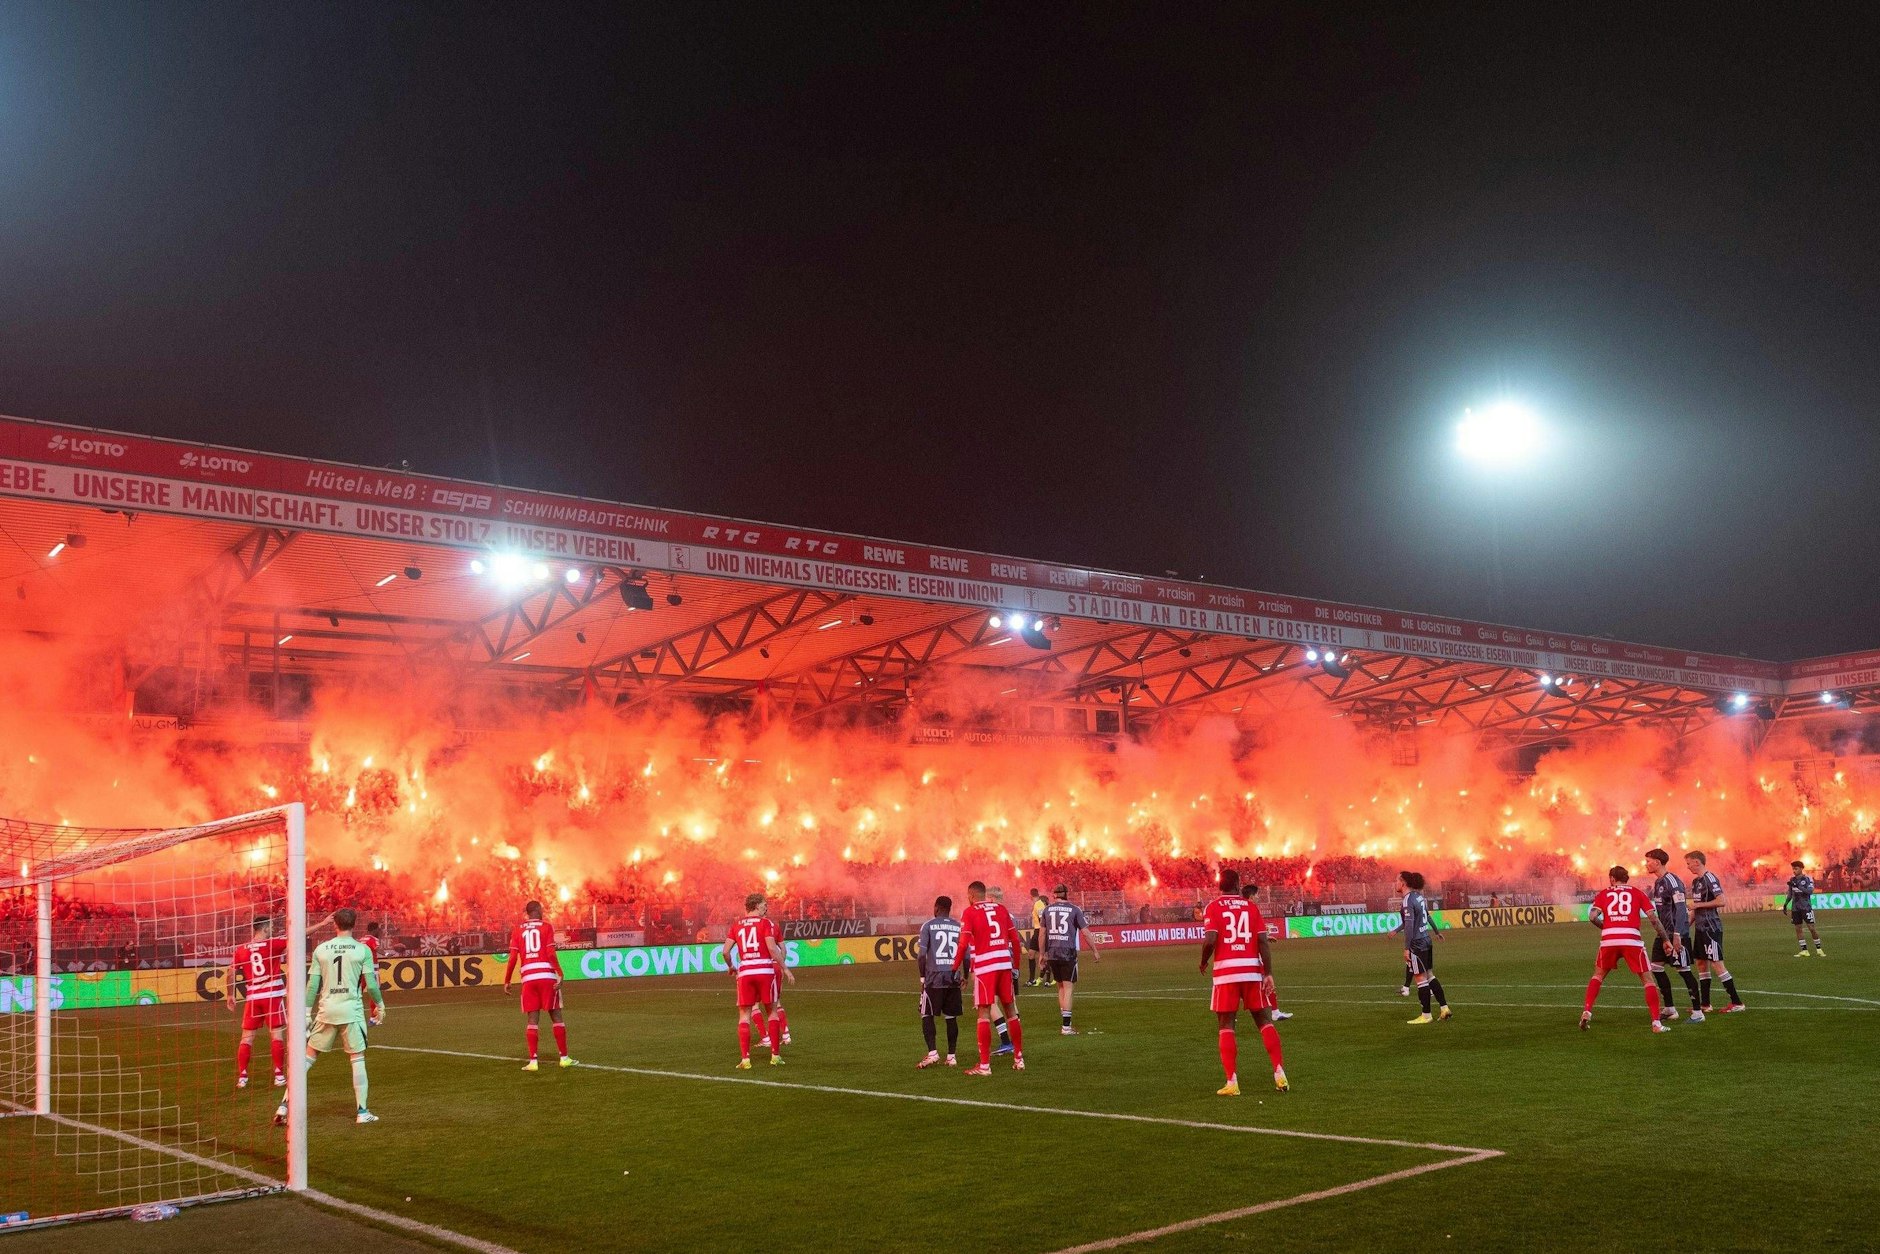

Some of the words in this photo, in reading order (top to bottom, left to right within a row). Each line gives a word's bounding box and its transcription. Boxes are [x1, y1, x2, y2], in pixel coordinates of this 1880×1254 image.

[71, 438, 125, 457] LOTTO
[201, 455, 250, 473] LOTTO
[73, 473, 171, 506] UNSERE
[182, 486, 343, 528] MANNSCHAFT.
[356, 508, 425, 537] UNSER
[430, 517, 497, 546] STOLZ.
[506, 526, 568, 554] UNSER
[572, 534, 642, 562] VEREIN.
[432, 489, 492, 512] ospa
[504, 499, 669, 533] SCHWIMMBADTECHNIK
[702, 526, 761, 545] RTC
[785, 537, 839, 555] RTC
[863, 546, 906, 565] REWE
[930, 555, 969, 573] REWE
[706, 552, 740, 573] UND
[744, 556, 812, 581] NIEMALS
[815, 564, 902, 592] VERGESSEN:
[908, 576, 955, 598] EISERN
[958, 583, 1004, 604] UNION!
[990, 562, 1028, 581] REWE
[1050, 571, 1084, 587] REWE
[1111, 579, 1143, 595] raisin
[1166, 586, 1196, 602] raisin
[1217, 593, 1245, 608] raisin
[1264, 600, 1293, 614] raisin
[1068, 594, 1142, 621] STADION
[1151, 605, 1171, 624] AN
[1179, 608, 1207, 628] DER
[1215, 613, 1261, 635] ALTEN
[1315, 607, 1330, 619] DIE
[1333, 609, 1382, 626] LOGISTIKER
[1401, 618, 1414, 630] DIE
[1417, 621, 1462, 636] LOGISTIKER
[1383, 634, 1401, 649] UND
[1403, 637, 1437, 655] NIEMALS
[1439, 642, 1484, 660] VERGESSEN:
[1486, 648, 1512, 662] EISERN
[1513, 651, 1538, 665] UNION!
[1564, 656, 1589, 671] UNSERE
[1590, 660, 1610, 673] LIEBE.
[1611, 663, 1635, 676] UNSERE
[1680, 671, 1699, 683] UNSER
[1835, 670, 1878, 686] UNSERE
[923, 728, 954, 738] KOCH
[1606, 891, 1633, 916] 28
[985, 910, 1001, 939] 5
[1049, 911, 1070, 935] 13
[1222, 911, 1252, 944] 34
[1312, 914, 1373, 937] CROWN
[1461, 908, 1514, 928] CROWN
[1516, 906, 1555, 925] COINS
[738, 926, 760, 953] 14
[782, 919, 865, 938] FRONTLINE
[1121, 927, 1156, 943] STADION
[1157, 928, 1169, 941] AN
[1170, 927, 1186, 940] DER
[1187, 926, 1206, 939] ALTE
[522, 928, 541, 953] 10
[874, 936, 920, 962] CRO
[935, 930, 959, 959] 25
[250, 952, 266, 976] 8
[333, 955, 343, 985] 1
[580, 947, 703, 979] CROWN
